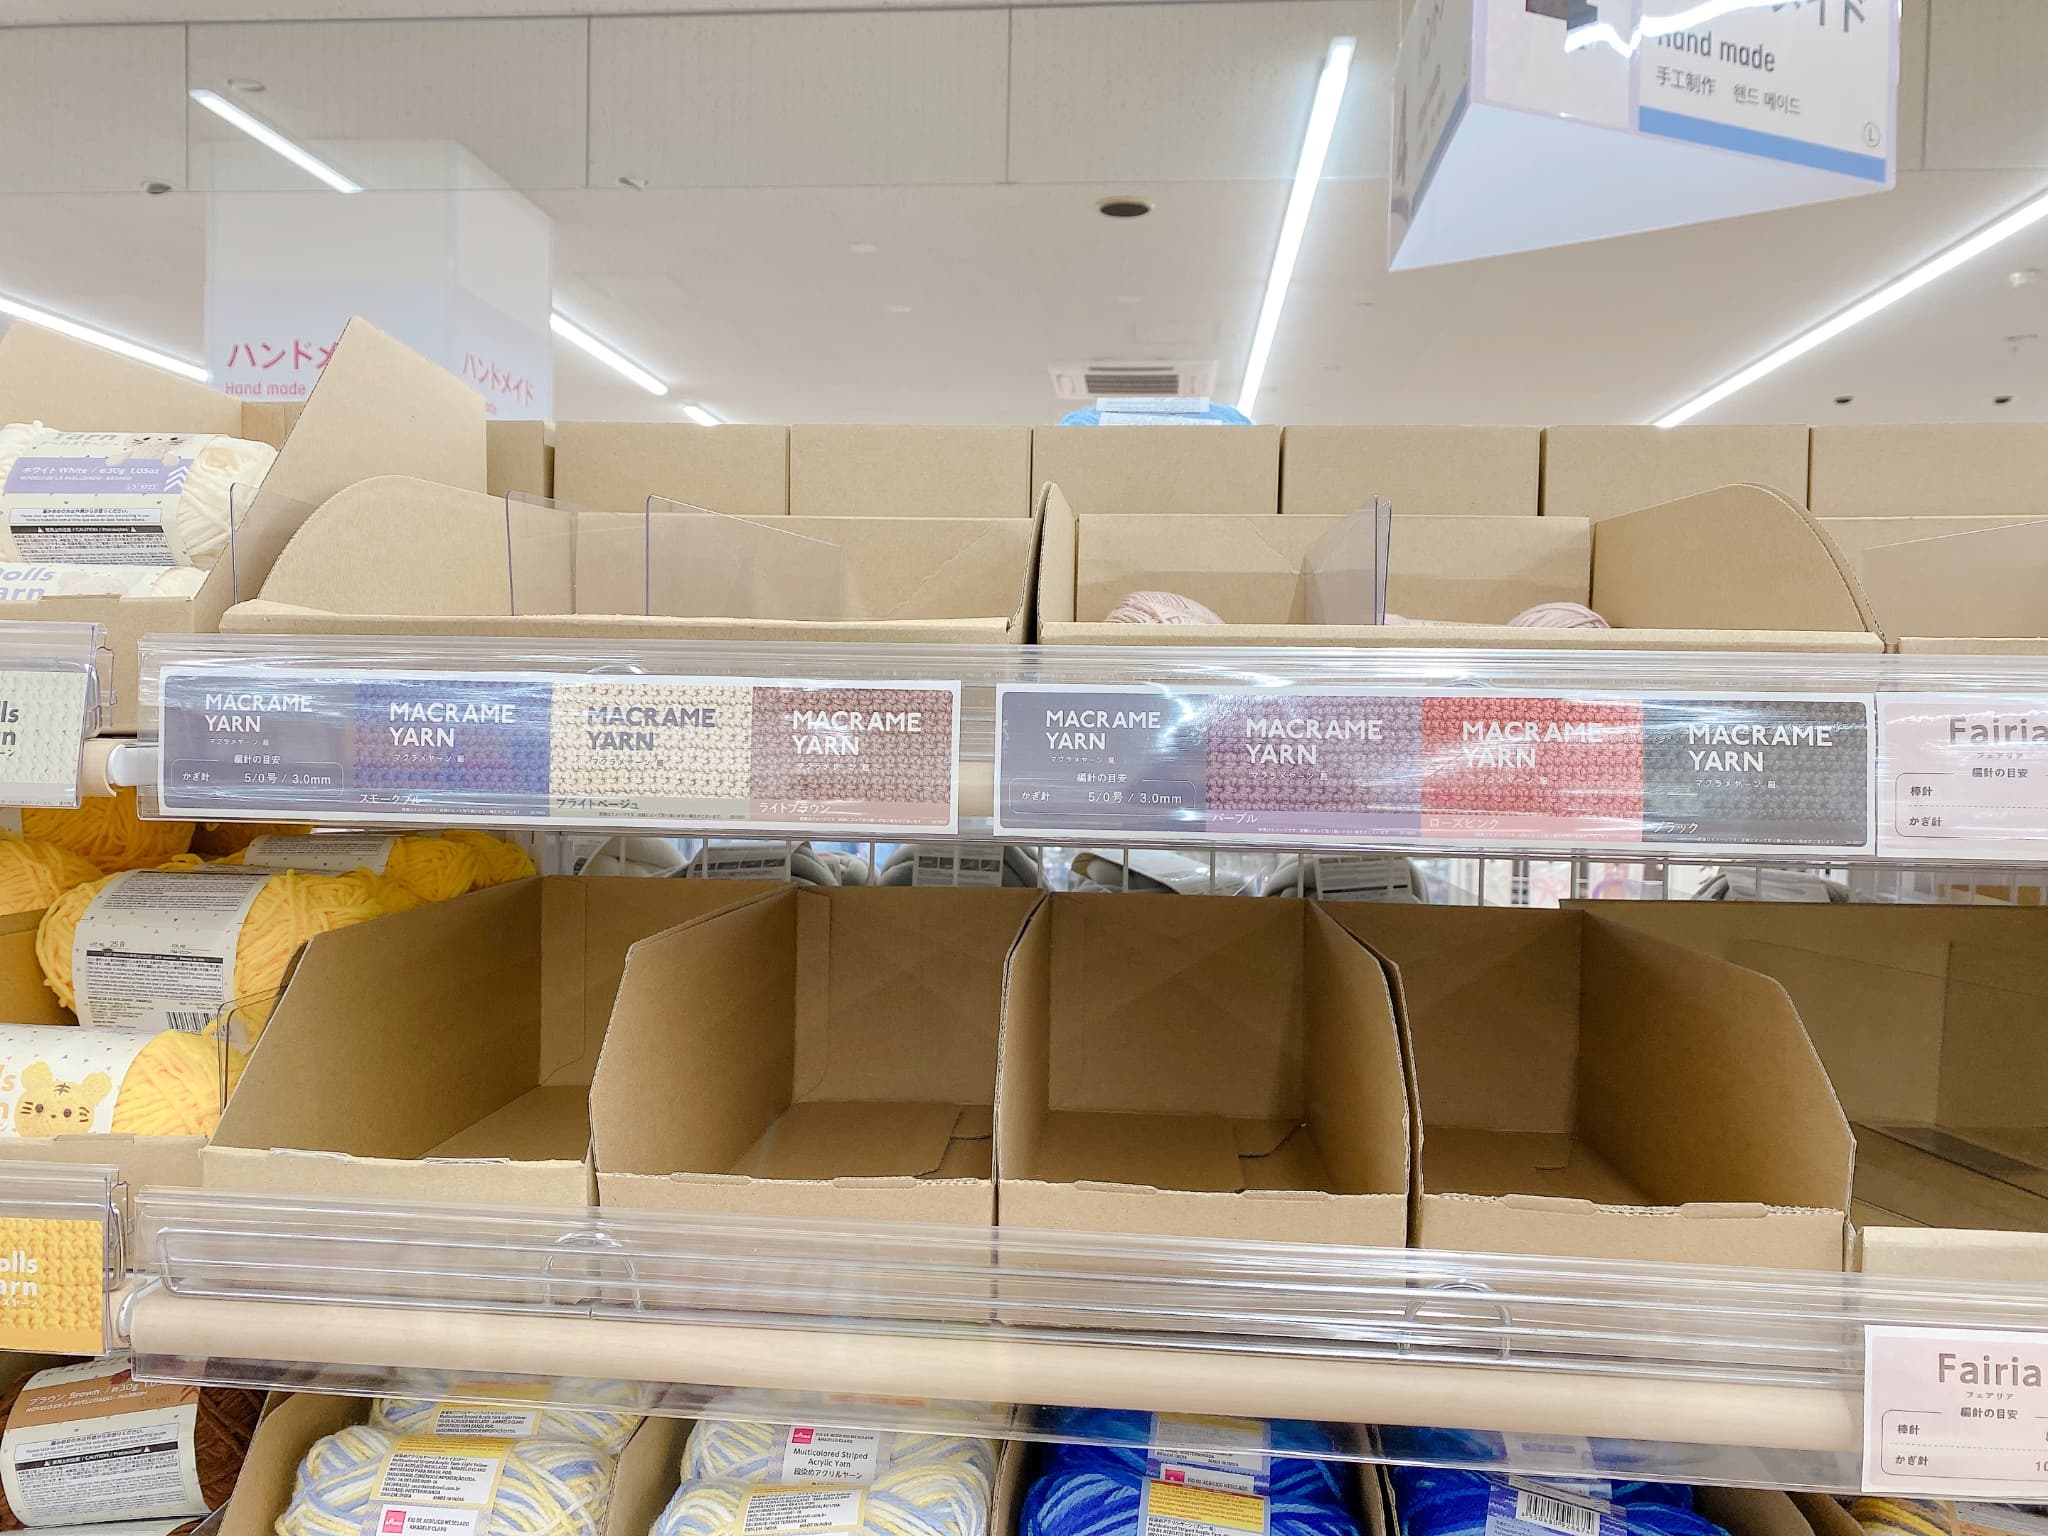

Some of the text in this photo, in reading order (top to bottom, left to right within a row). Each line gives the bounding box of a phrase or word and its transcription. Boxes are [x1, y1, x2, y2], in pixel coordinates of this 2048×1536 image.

[1720, 39, 1775, 72] made
[1656, 65, 1716, 97] 手工制作
[1764, 92, 1801, 115] 메이드
[463, 351, 535, 407] ハンドメイド
[225, 382, 306, 396] Hand made
[59, 466, 88, 474] White
[205, 693, 313, 712] MACRAME
[389, 702, 516, 723] MACRAME
[587, 706, 716, 728] MACRAME
[792, 710, 922, 733] MACRAME
[1045, 710, 1161, 729] MACRAME
[204, 714, 261, 732] YARN
[1246, 719, 1383, 741] MACRAME
[1462, 721, 1603, 743] MACRAME
[1949, 718, 2048, 745] Fairia
[389, 726, 455, 747] YARN
[587, 730, 654, 751] YARN
[1045, 732, 1106, 750] YARN
[1687, 723, 1834, 747] MACRAME
[792, 734, 859, 756] YARN
[234, 754, 280, 765] 編針の目安
[1246, 744, 1317, 765] YARN
[1463, 747, 1536, 768] YARN
[1688, 750, 1764, 772] YARN
[182, 772, 210, 781] かぎ針
[244, 773, 278, 783] 5/0号
[292, 774, 331, 785] 3.0mm
[1077, 772, 1127, 783] 編針の目安
[1972, 767, 2029, 778] 編針の目安
[1022, 791, 1050, 801] かぎ針
[1088, 791, 1124, 804] 5/0号
[1140, 793, 1182, 804] 3.0mm
[1910, 785, 1933, 797] 棒針
[759, 801, 830, 814] ライトブラウン
[1212, 812, 1258, 824] パープル
[1654, 820, 1700, 834] ブラック
[1908, 817, 1942, 827] かぎ針
[1938, 1353, 2042, 1387] Fairia
[29, 1393, 66, 1406] ブラウン
[69, 1388, 100, 1400] Brown
[1966, 1391, 2014, 1400] フェアリア
[1960, 1407, 2018, 1420] 編針の目安
[1897, 1424, 1920, 1435] 棒針
[793, 1448, 868, 1461] Multicolored Striped
[808, 1458, 851, 1468] Acrylic Yarn
[1895, 1455, 1928, 1466] かぎ針
